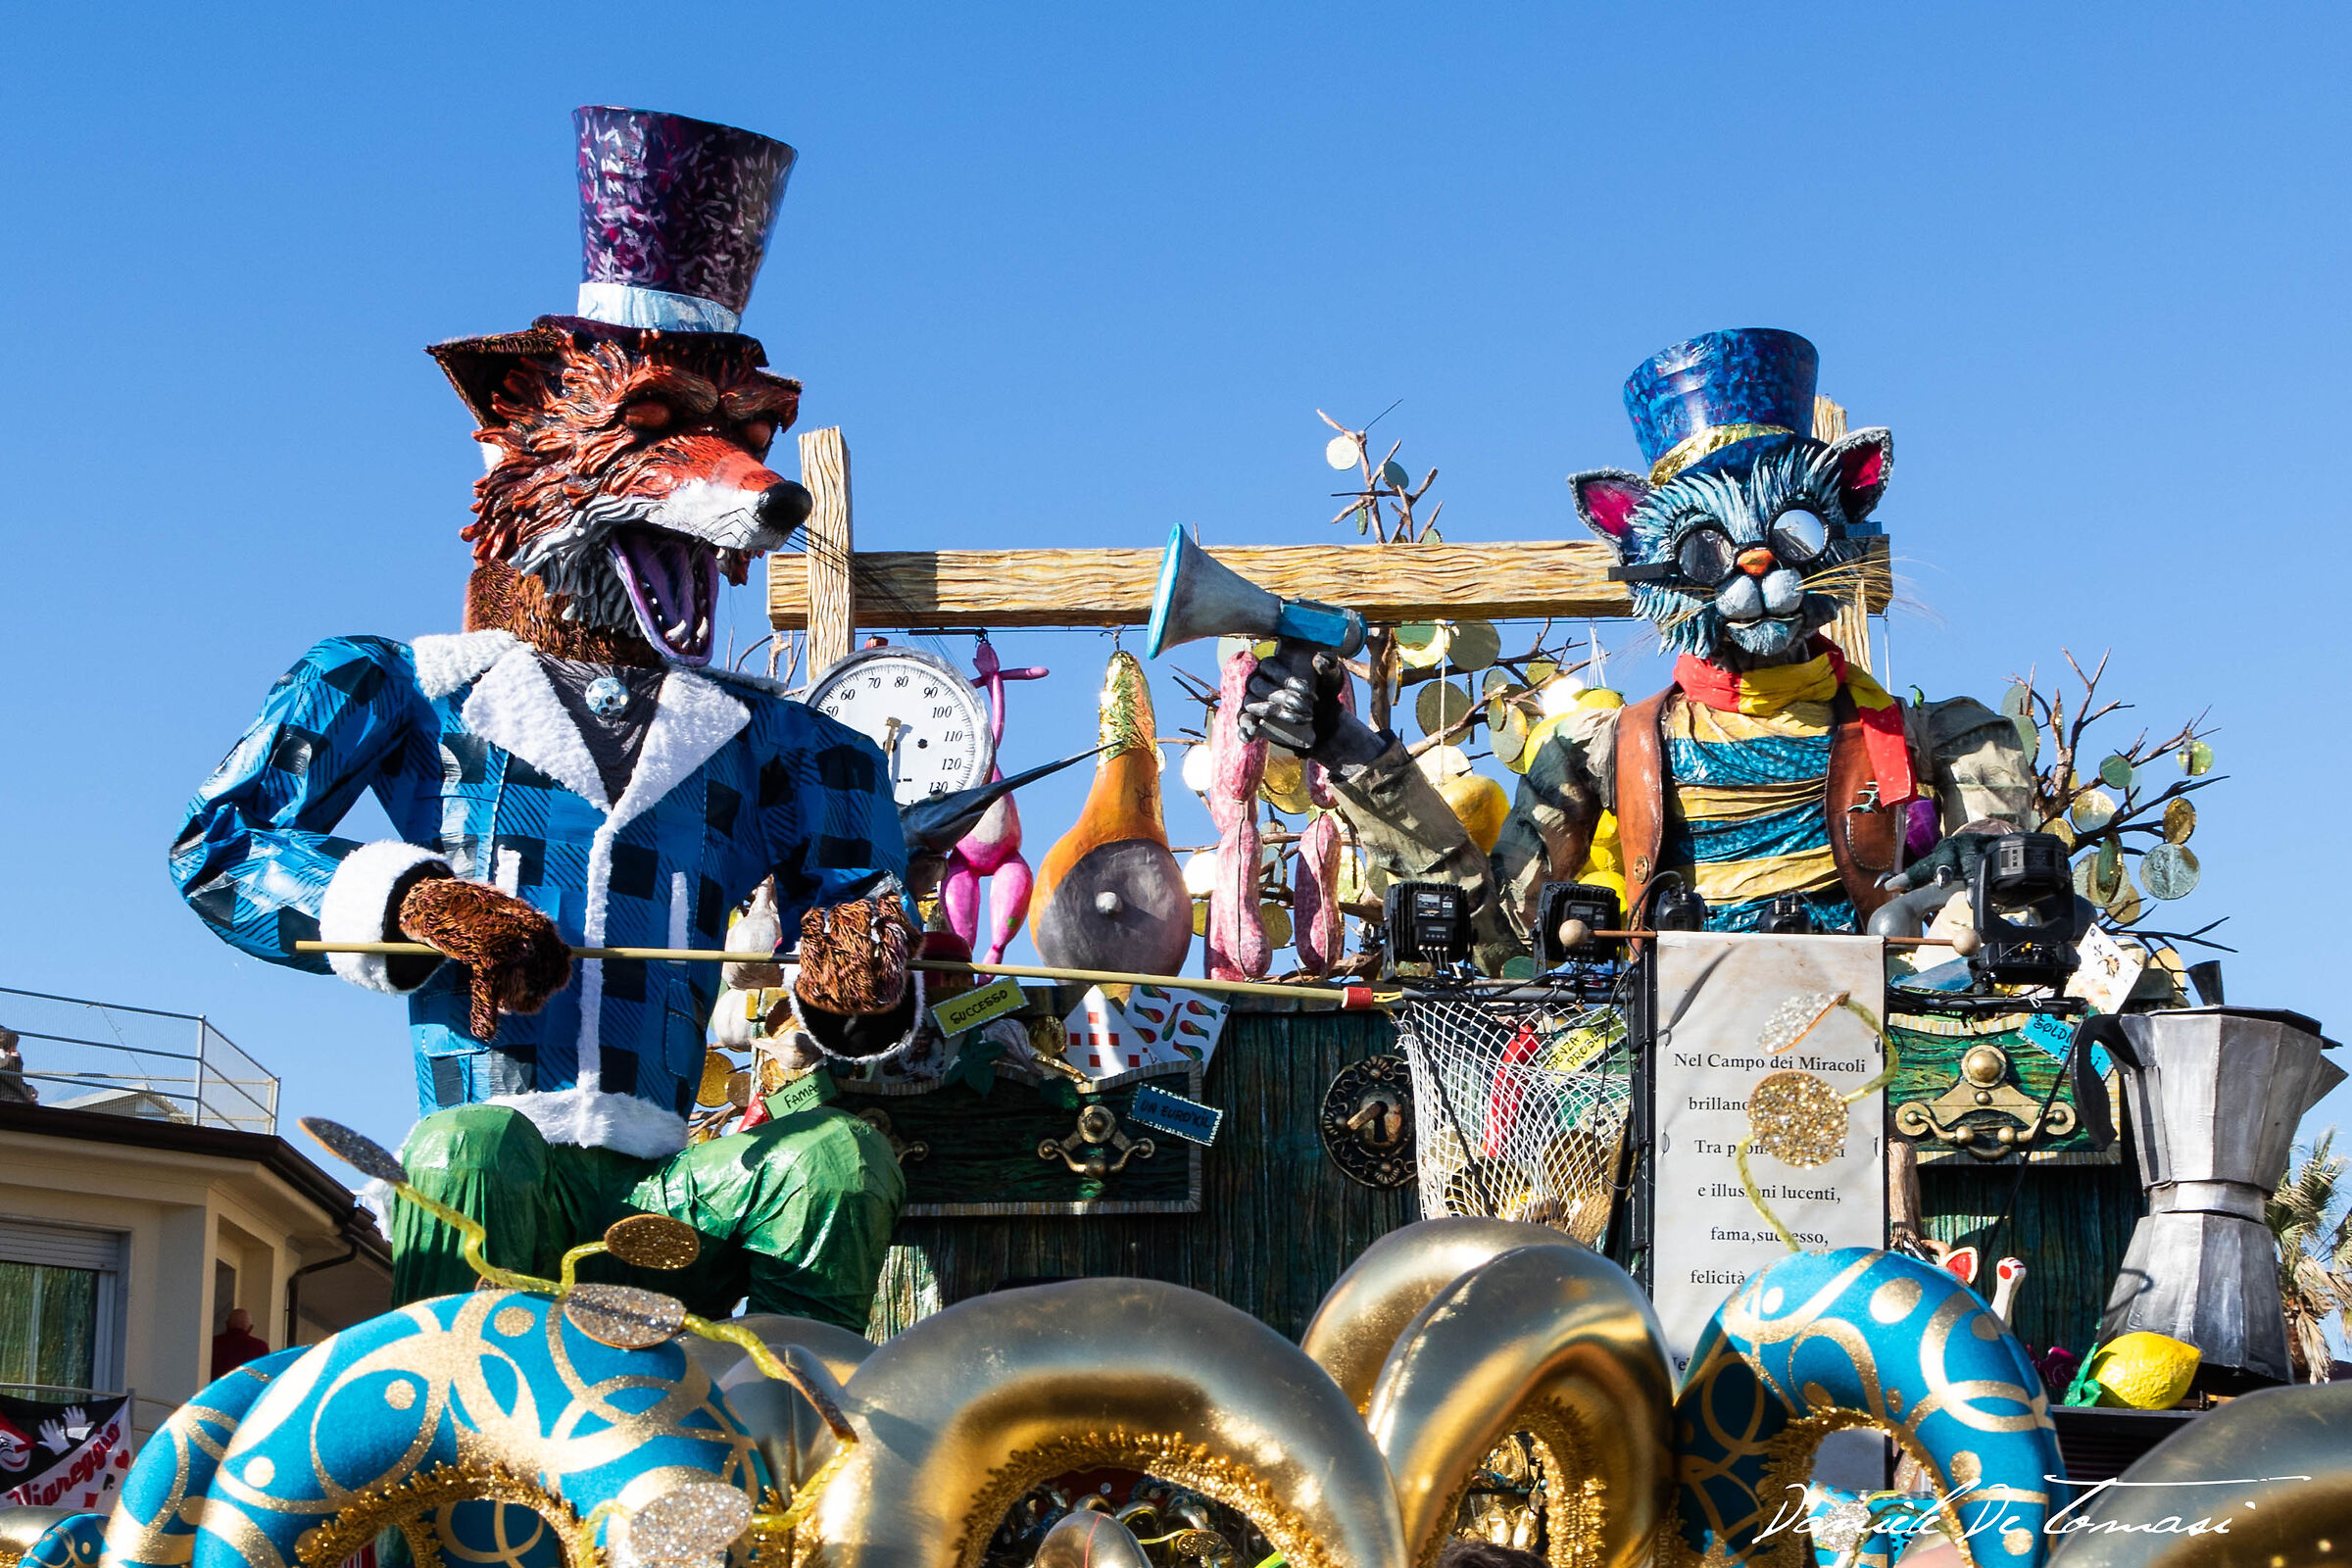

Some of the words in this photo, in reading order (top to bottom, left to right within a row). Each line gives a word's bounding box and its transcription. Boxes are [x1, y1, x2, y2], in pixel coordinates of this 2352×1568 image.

[867, 677, 881, 689] 70
[894, 676, 908, 688] 80
[840, 688, 856, 701] 60
[923, 687, 938, 699] 90
[825, 706, 839, 717] 50
[932, 706, 953, 718] 100
[944, 730, 963, 742] 110
[942, 759, 961, 770] 120
[928, 781, 949, 794] 130
[950, 990, 1007, 1024] SUCCESSO
[1674, 1054, 1702, 1067] Nel
[1707, 1054, 1765, 1071] Campo
[1770, 1055, 1793, 1069] dei
[1799, 1056, 1866, 1073] Miracoli
[784, 1084, 819, 1109] FAMA
[1694, 1140, 1722, 1154] Tra
[1697, 1186, 1706, 1197] e
[1711, 1183, 1777, 1199] illusni
[1782, 1185, 1841, 1204] lucenti,
[1690, 1269, 1745, 1285] felicità
[6, 1420, 121, 1506] Viareggio
